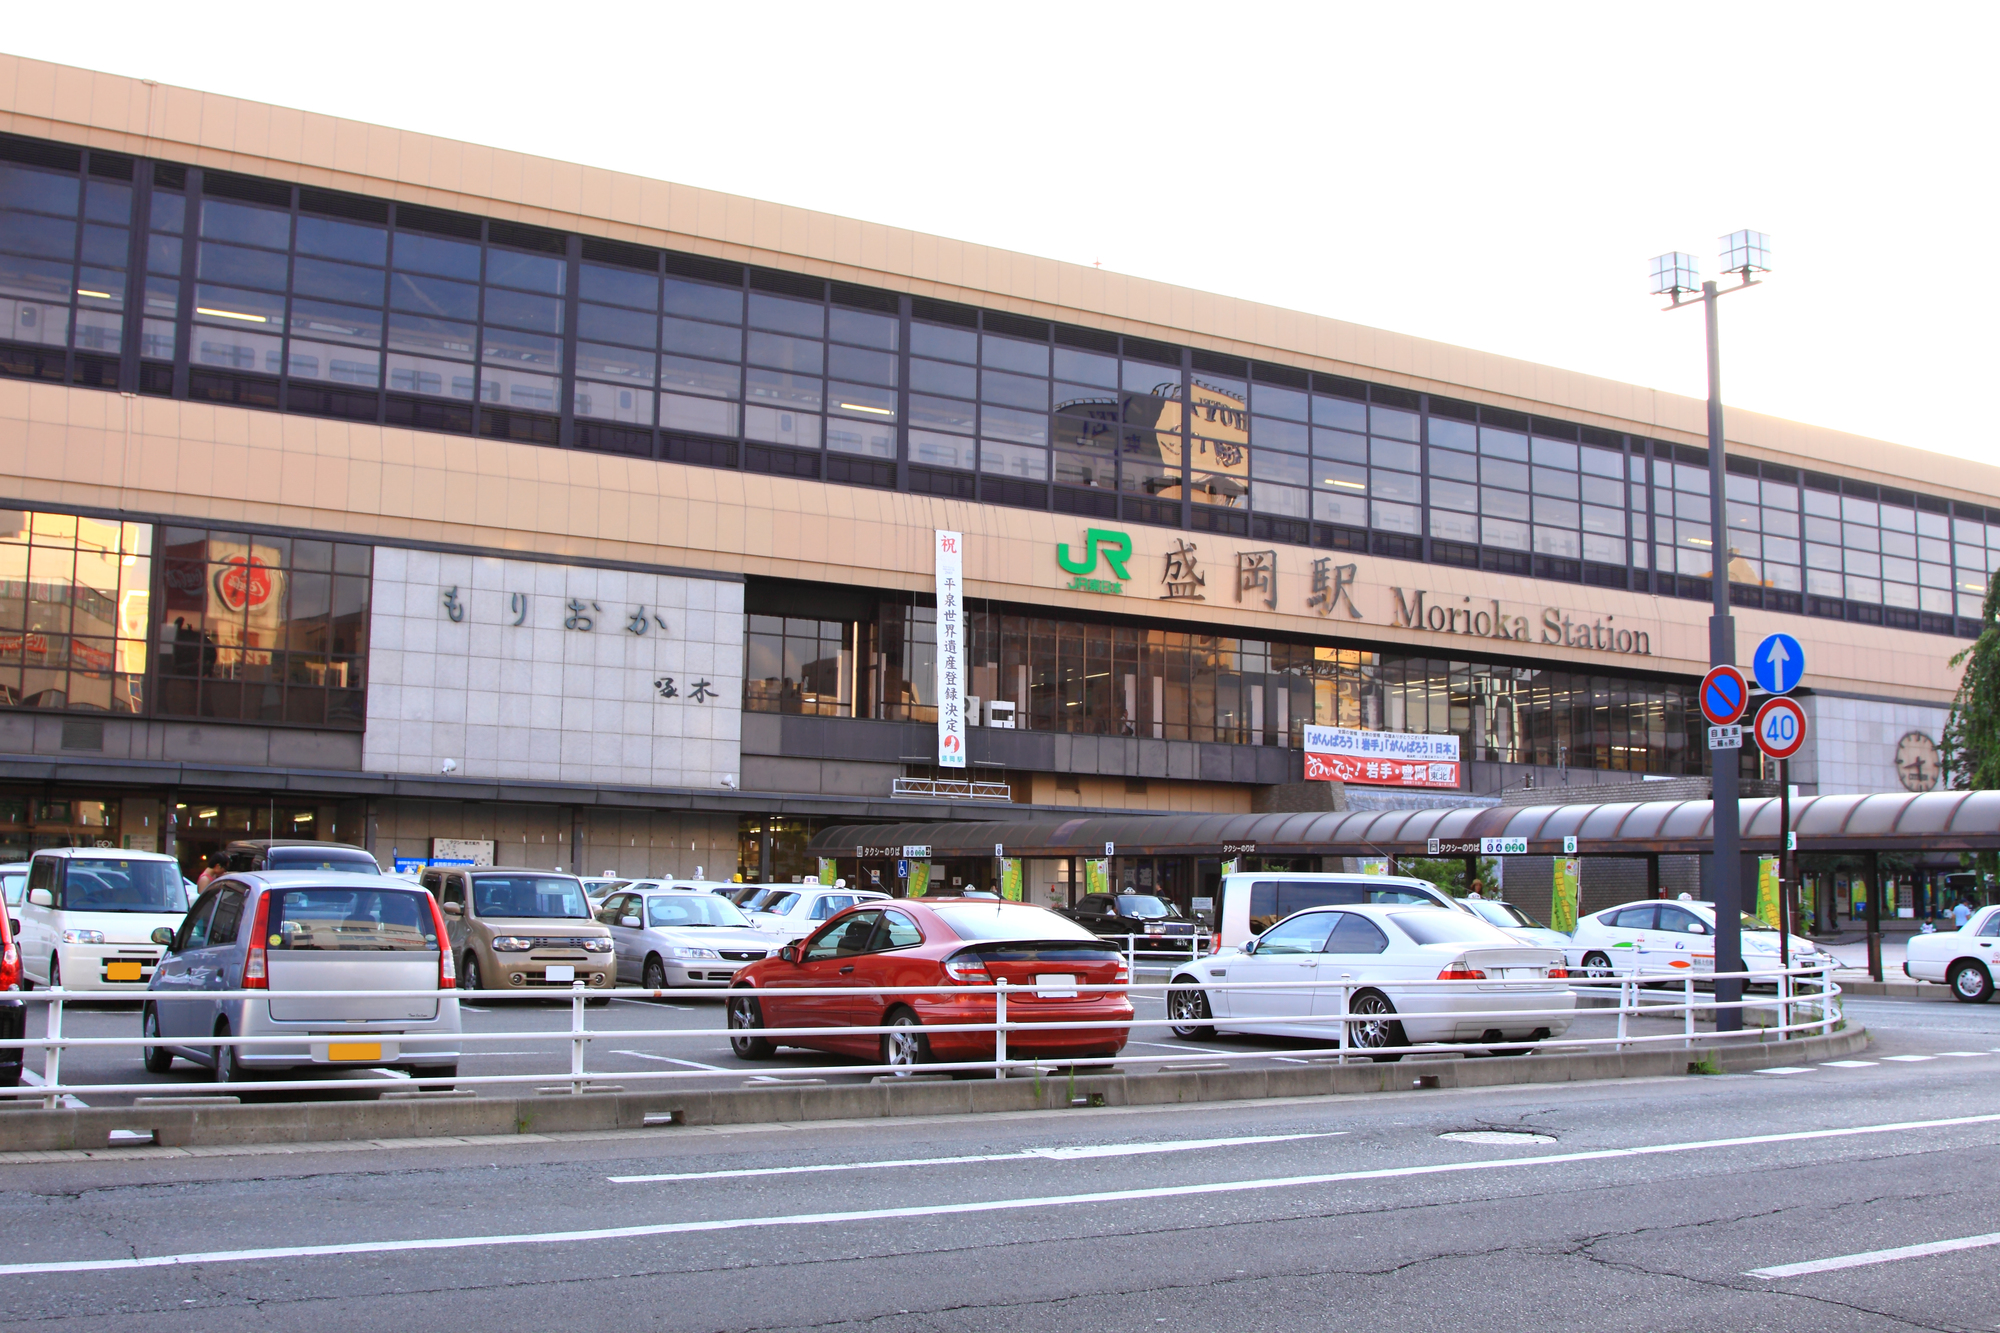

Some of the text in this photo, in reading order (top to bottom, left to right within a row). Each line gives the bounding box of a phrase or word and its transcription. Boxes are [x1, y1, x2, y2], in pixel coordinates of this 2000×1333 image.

[940, 535, 957, 554] 祝
[1058, 528, 1132, 580] JR
[1067, 577, 1123, 594] JR東日本
[1159, 538, 1362, 618] 盛岡駅
[443, 586, 668, 636] もりおか
[1391, 587, 1652, 655] Morioka Station
[943, 577, 959, 732] 平泉世界遺産登録決定
[1711, 728, 1739, 738] 自動車
[1767, 715, 1794, 741] 40
[1711, 739, 1740, 748] 二輪を除く
[942, 755, 963, 763] 盛岡駅
[864, 847, 900, 857] タクシーのりば
[1223, 844, 1255, 853] タクシーのりば
[1440, 843, 1480, 853] タクシーのりば
